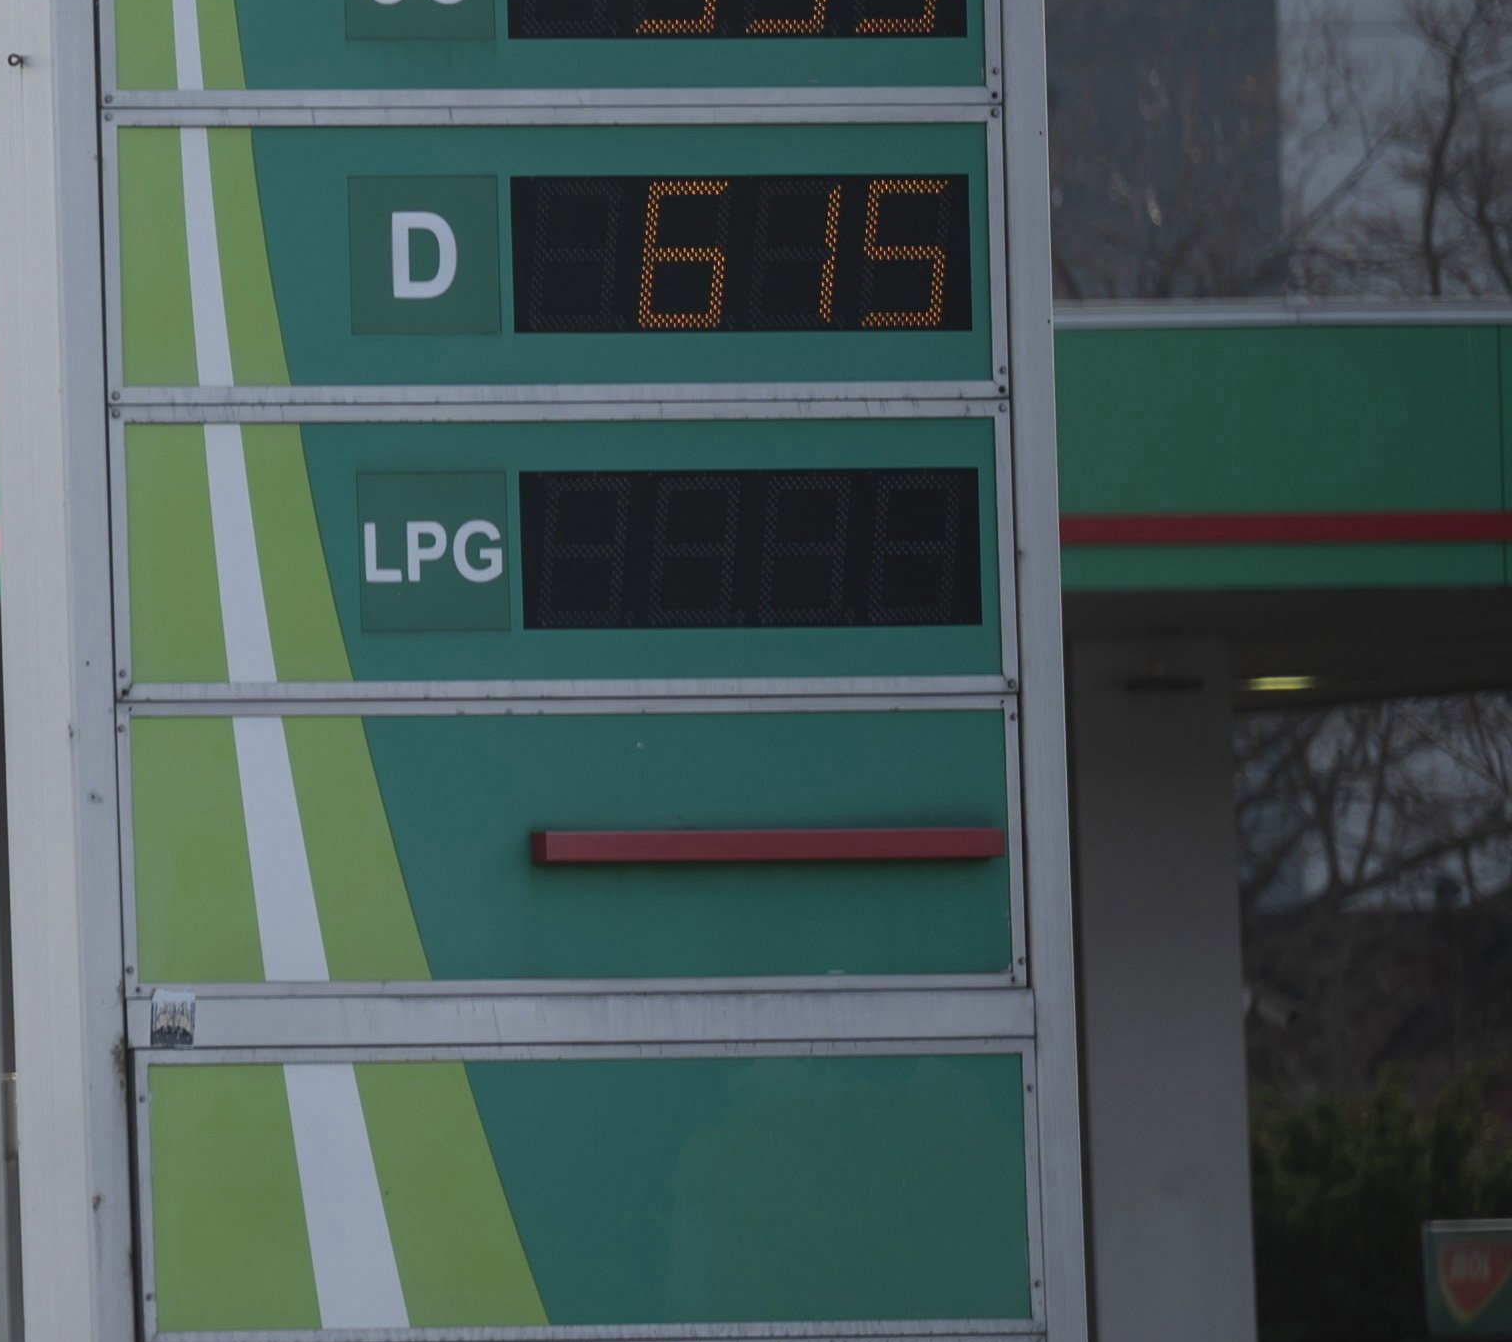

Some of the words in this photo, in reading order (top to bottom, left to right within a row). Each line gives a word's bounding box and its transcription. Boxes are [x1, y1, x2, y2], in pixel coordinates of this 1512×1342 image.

[390, 211, 458, 300] D
[638, 179, 949, 329] 615
[363, 520, 505, 584] LPG
